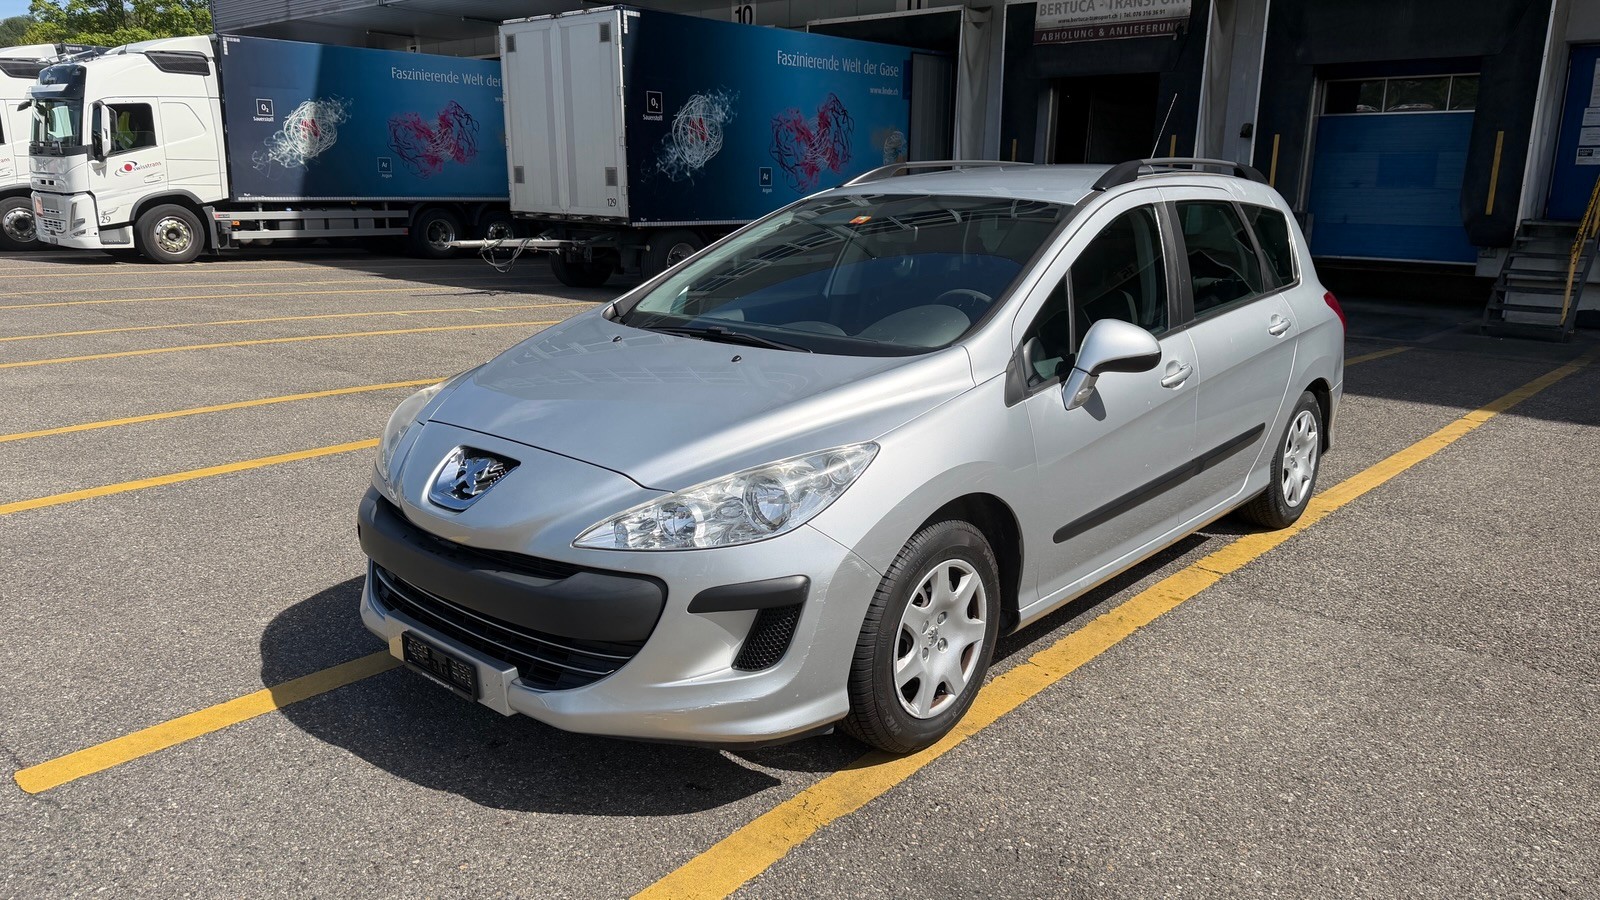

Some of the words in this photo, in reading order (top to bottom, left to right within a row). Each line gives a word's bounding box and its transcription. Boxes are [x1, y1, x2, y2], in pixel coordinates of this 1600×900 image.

[734, 5, 753, 25] 10
[1039, 0, 1095, 16] BERTUCA
[1108, 0, 1187, 9] TRANS
[1041, 28, 1094, 41] ABHOLUNG
[1098, 28, 1105, 37] &
[777, 50, 840, 71] Faszinierende
[842, 58, 861, 73] Welt
[863, 60, 878, 76] der
[879, 62, 899, 78] Gase
[391, 67, 459, 84] Faszinierende
[461, 73, 484, 86] Welt
[486, 74, 501, 87] der
[607, 197, 617, 207] 129
[101, 216, 111, 224] 29
